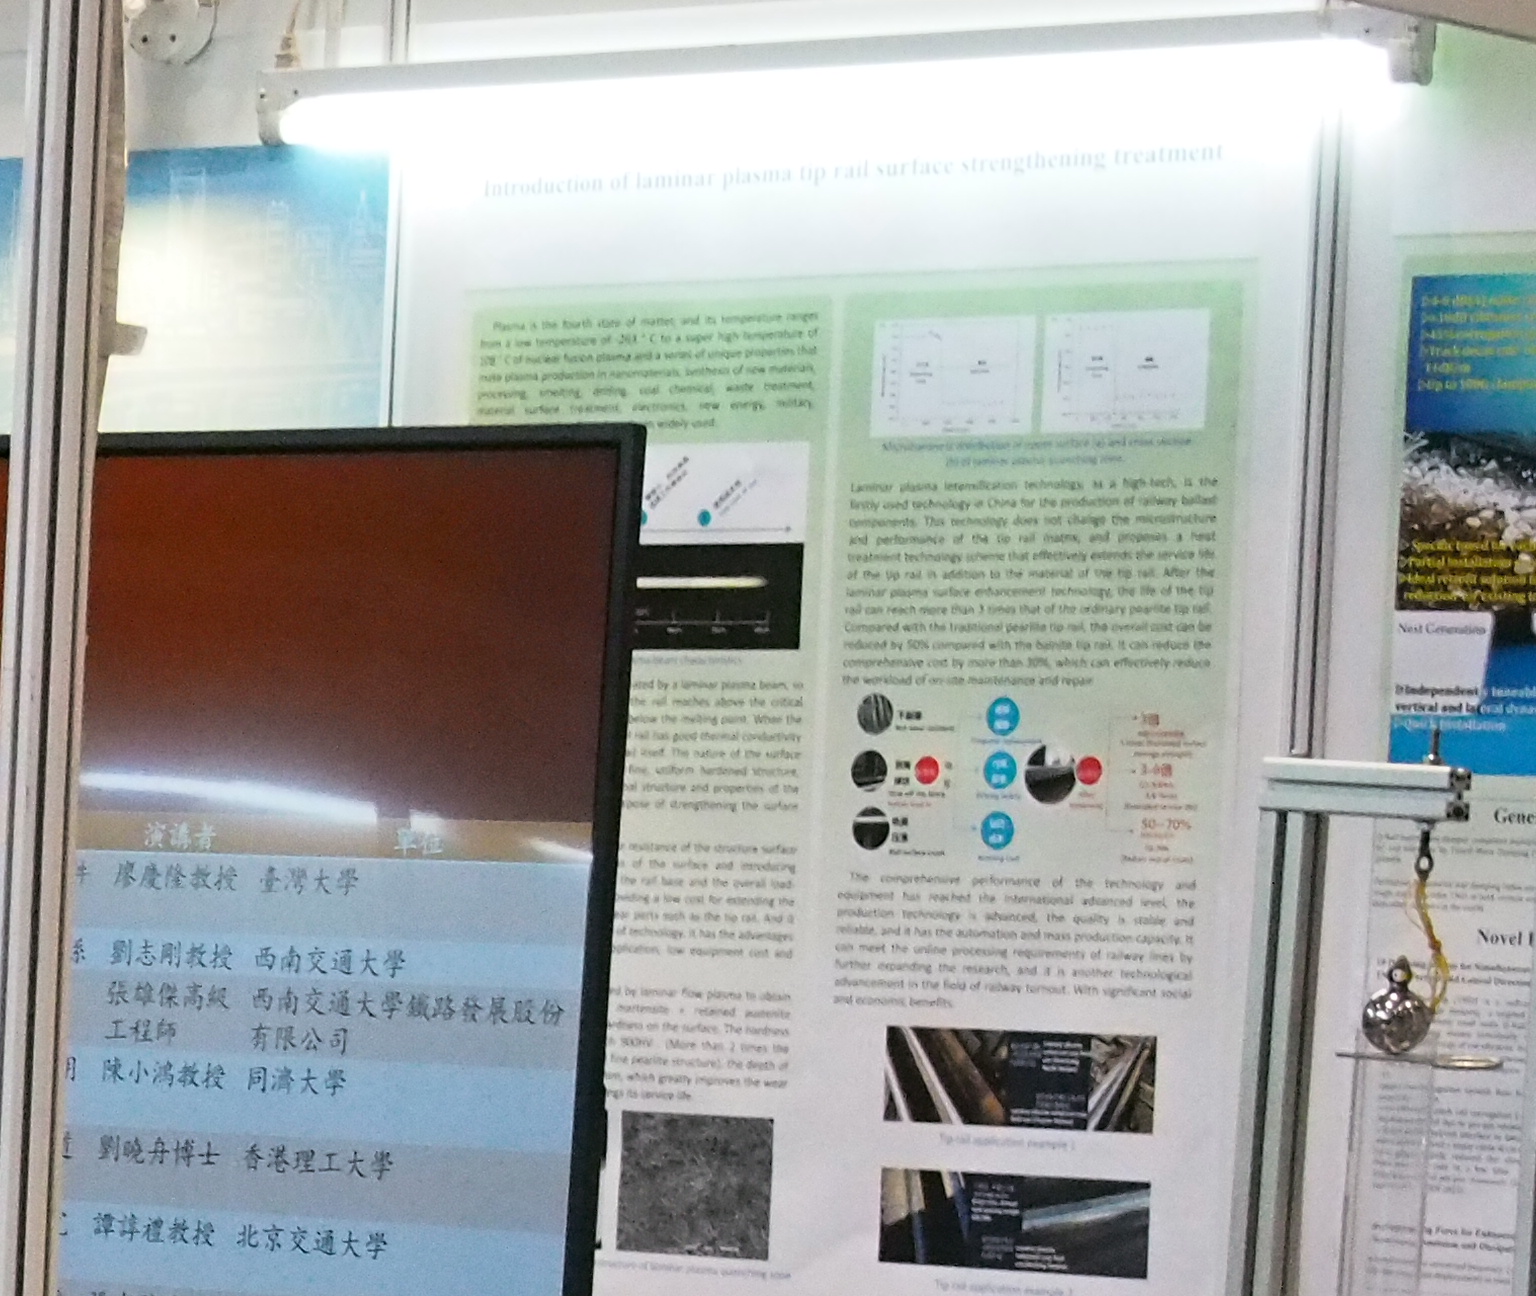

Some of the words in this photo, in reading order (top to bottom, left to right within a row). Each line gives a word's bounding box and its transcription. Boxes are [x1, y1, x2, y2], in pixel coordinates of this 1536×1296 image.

[1494, 807, 1536, 825] Gene
[254, 945, 406, 979] 西南交通大學
[105, 1018, 177, 1045] 工程師
[251, 1021, 350, 1056] 有限公司
[247, 1065, 346, 1098] 同濟大學
[243, 1146, 394, 1181] 香港理工大學
[235, 1223, 389, 1262] 北京交通大學
